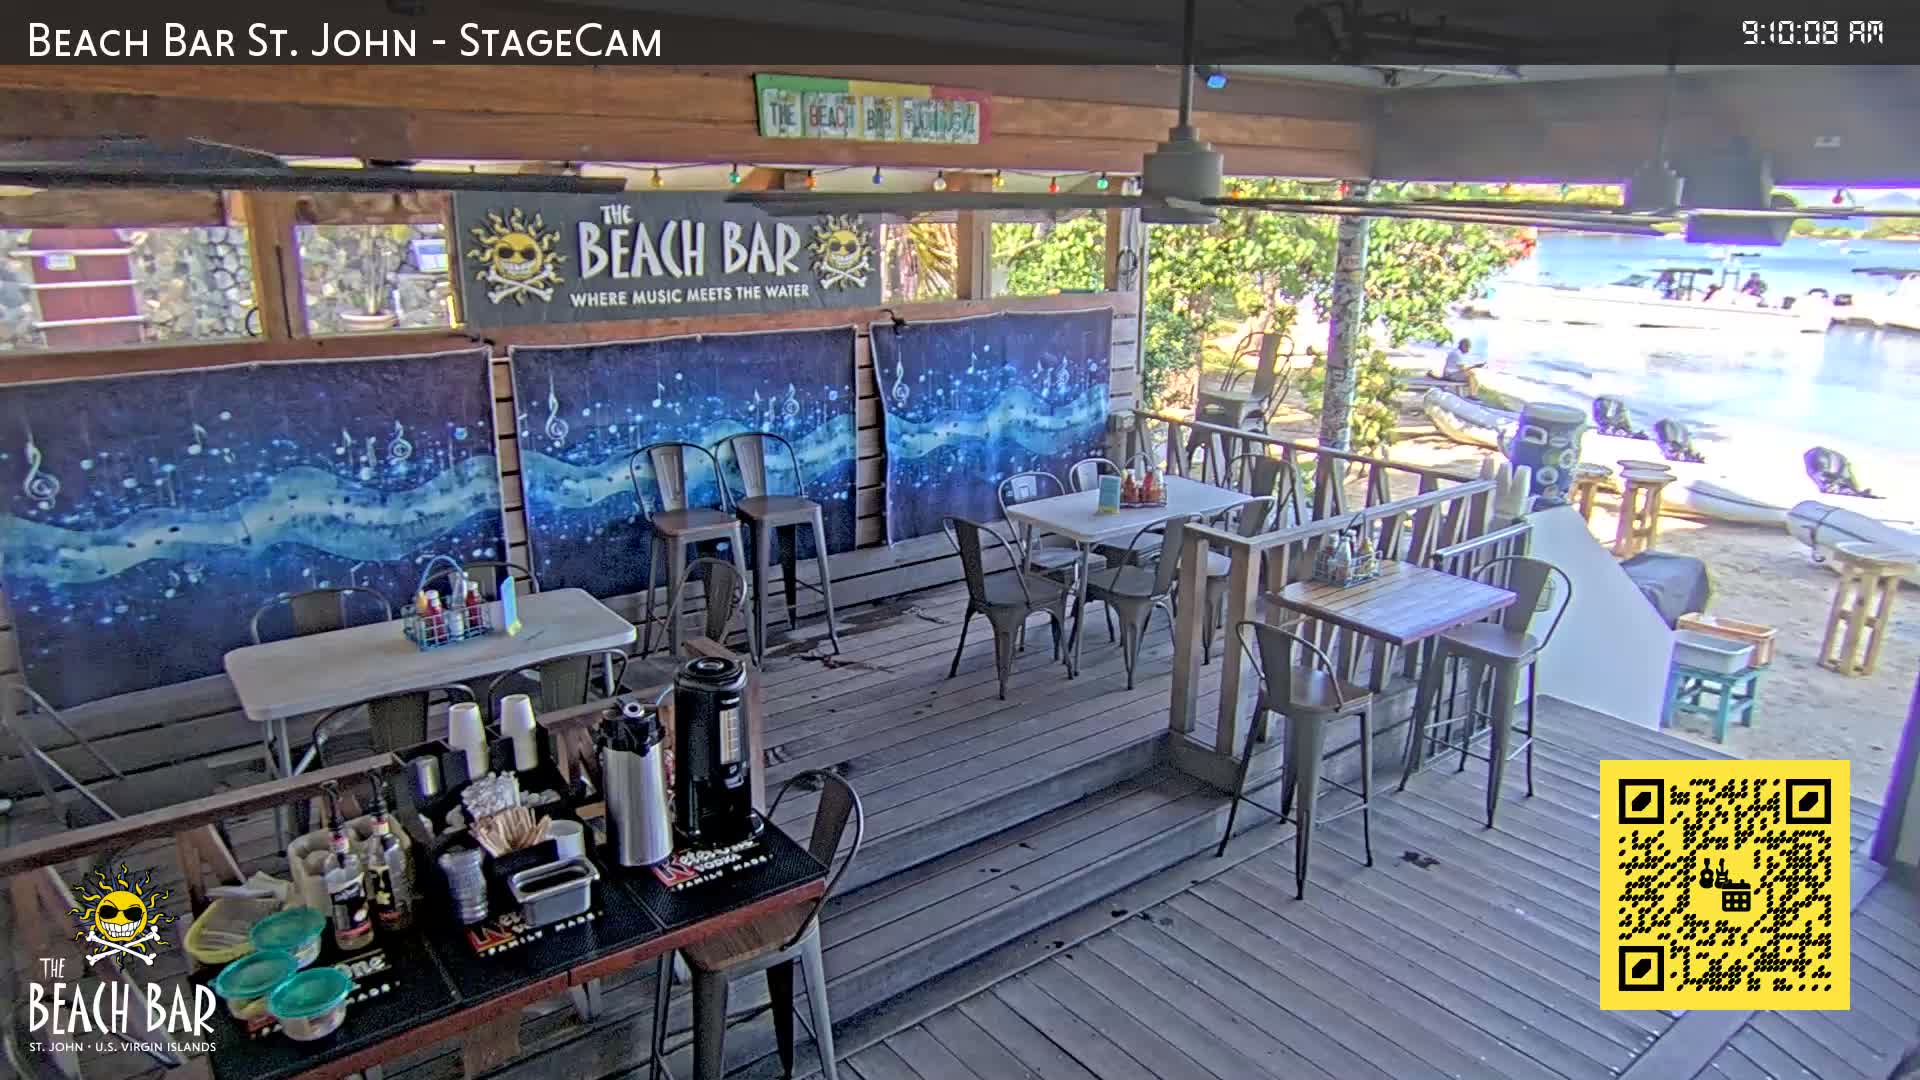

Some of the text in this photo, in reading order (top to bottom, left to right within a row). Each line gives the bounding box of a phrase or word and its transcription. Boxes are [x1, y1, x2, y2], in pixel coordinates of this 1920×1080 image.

[769, 103, 797, 126] THE
[809, 103, 855, 129] BEACH
[867, 107, 892, 131] BAR
[599, 204, 634, 226] THE
[578, 219, 802, 280] BEACH BAR
[570, 283, 810, 308] WHERE MUSIC MEETS THE WATER
